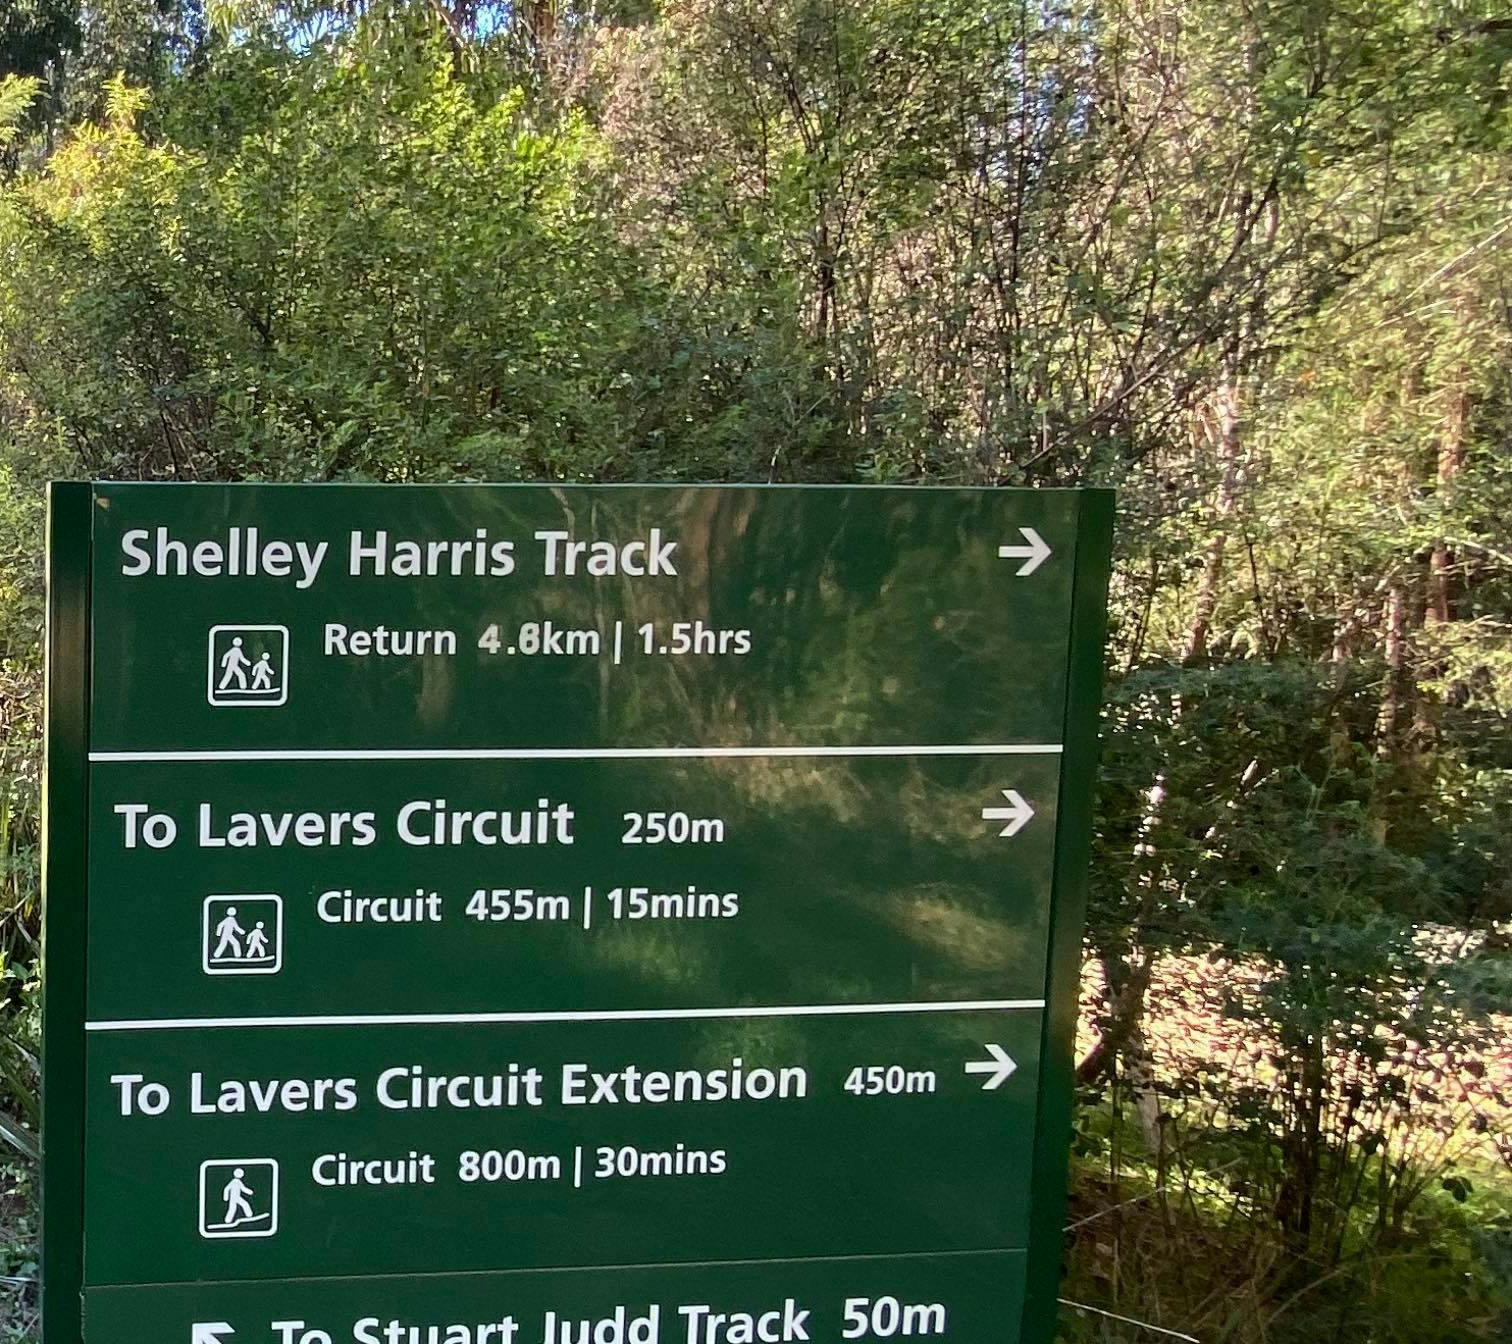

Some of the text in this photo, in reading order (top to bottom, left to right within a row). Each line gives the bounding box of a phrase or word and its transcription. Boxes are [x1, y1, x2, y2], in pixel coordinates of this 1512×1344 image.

[121, 526, 678, 589] Shelley Harris Track
[324, 623, 457, 656] Return
[638, 620, 751, 655] 1.5hrs
[113, 798, 724, 848] To Lavers Circuit 250m
[317, 888, 442, 923] Circuit
[465, 889, 570, 921] 455m
[607, 885, 739, 919] 15mins
[110, 1057, 936, 1116] To Lavers Circuit Extension 450m
[311, 1151, 435, 1186] Circuit
[458, 1149, 561, 1182] 800m
[594, 1143, 726, 1178] 30mins
[842, 1295, 946, 1339] 50m
